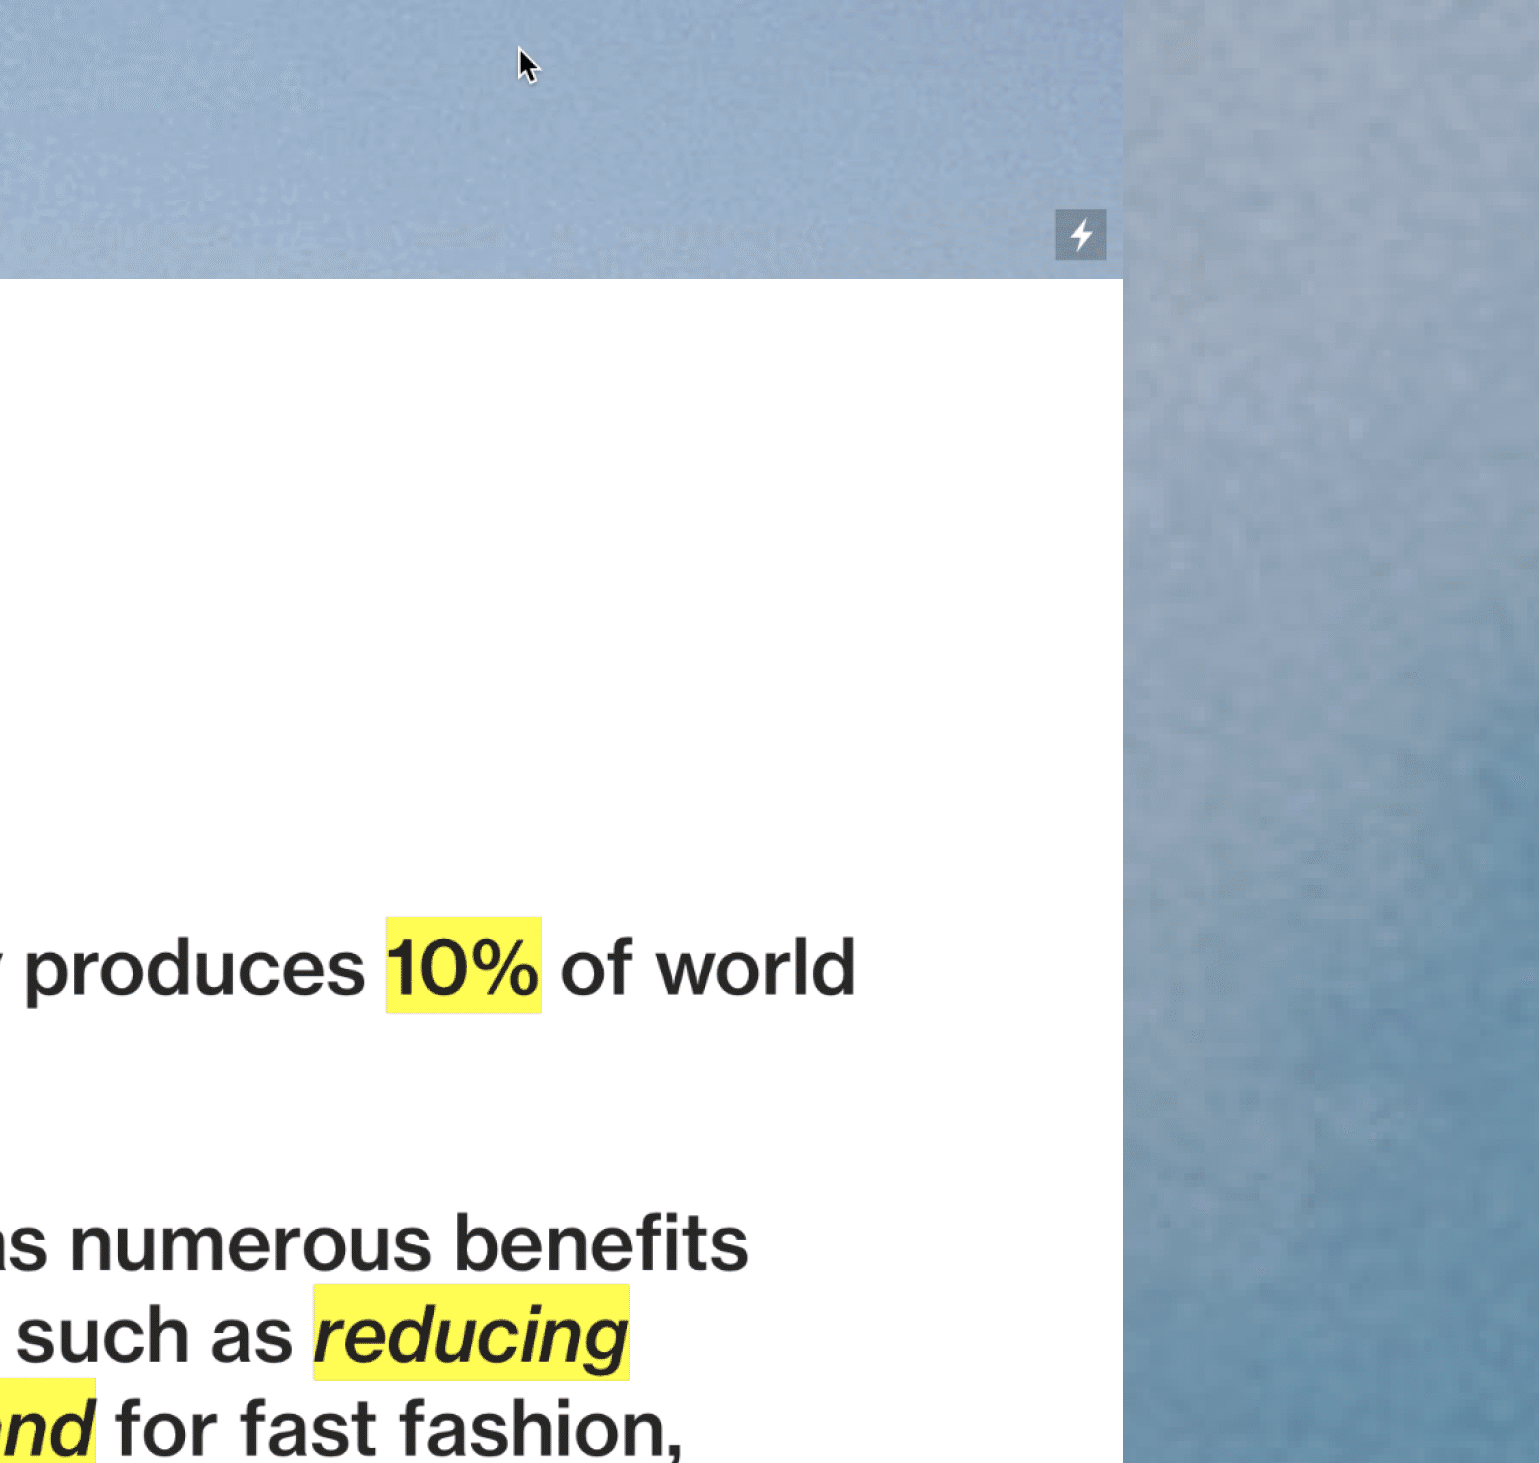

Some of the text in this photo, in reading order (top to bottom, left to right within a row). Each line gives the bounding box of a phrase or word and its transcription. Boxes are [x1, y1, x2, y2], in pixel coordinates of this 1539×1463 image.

[26, 936, 365, 1009] produces
[388, 938, 539, 996] 10%
[561, 936, 633, 996] of
[655, 936, 854, 996] world
[72, 1227, 431, 1272] numerous
[456, 1212, 748, 1272] benefits
[17, 1303, 188, 1364] such
[211, 1319, 293, 1364] as
[313, 1303, 629, 1377] reducing
[114, 1397, 218, 1457] for
[240, 1397, 377, 1458] fast
